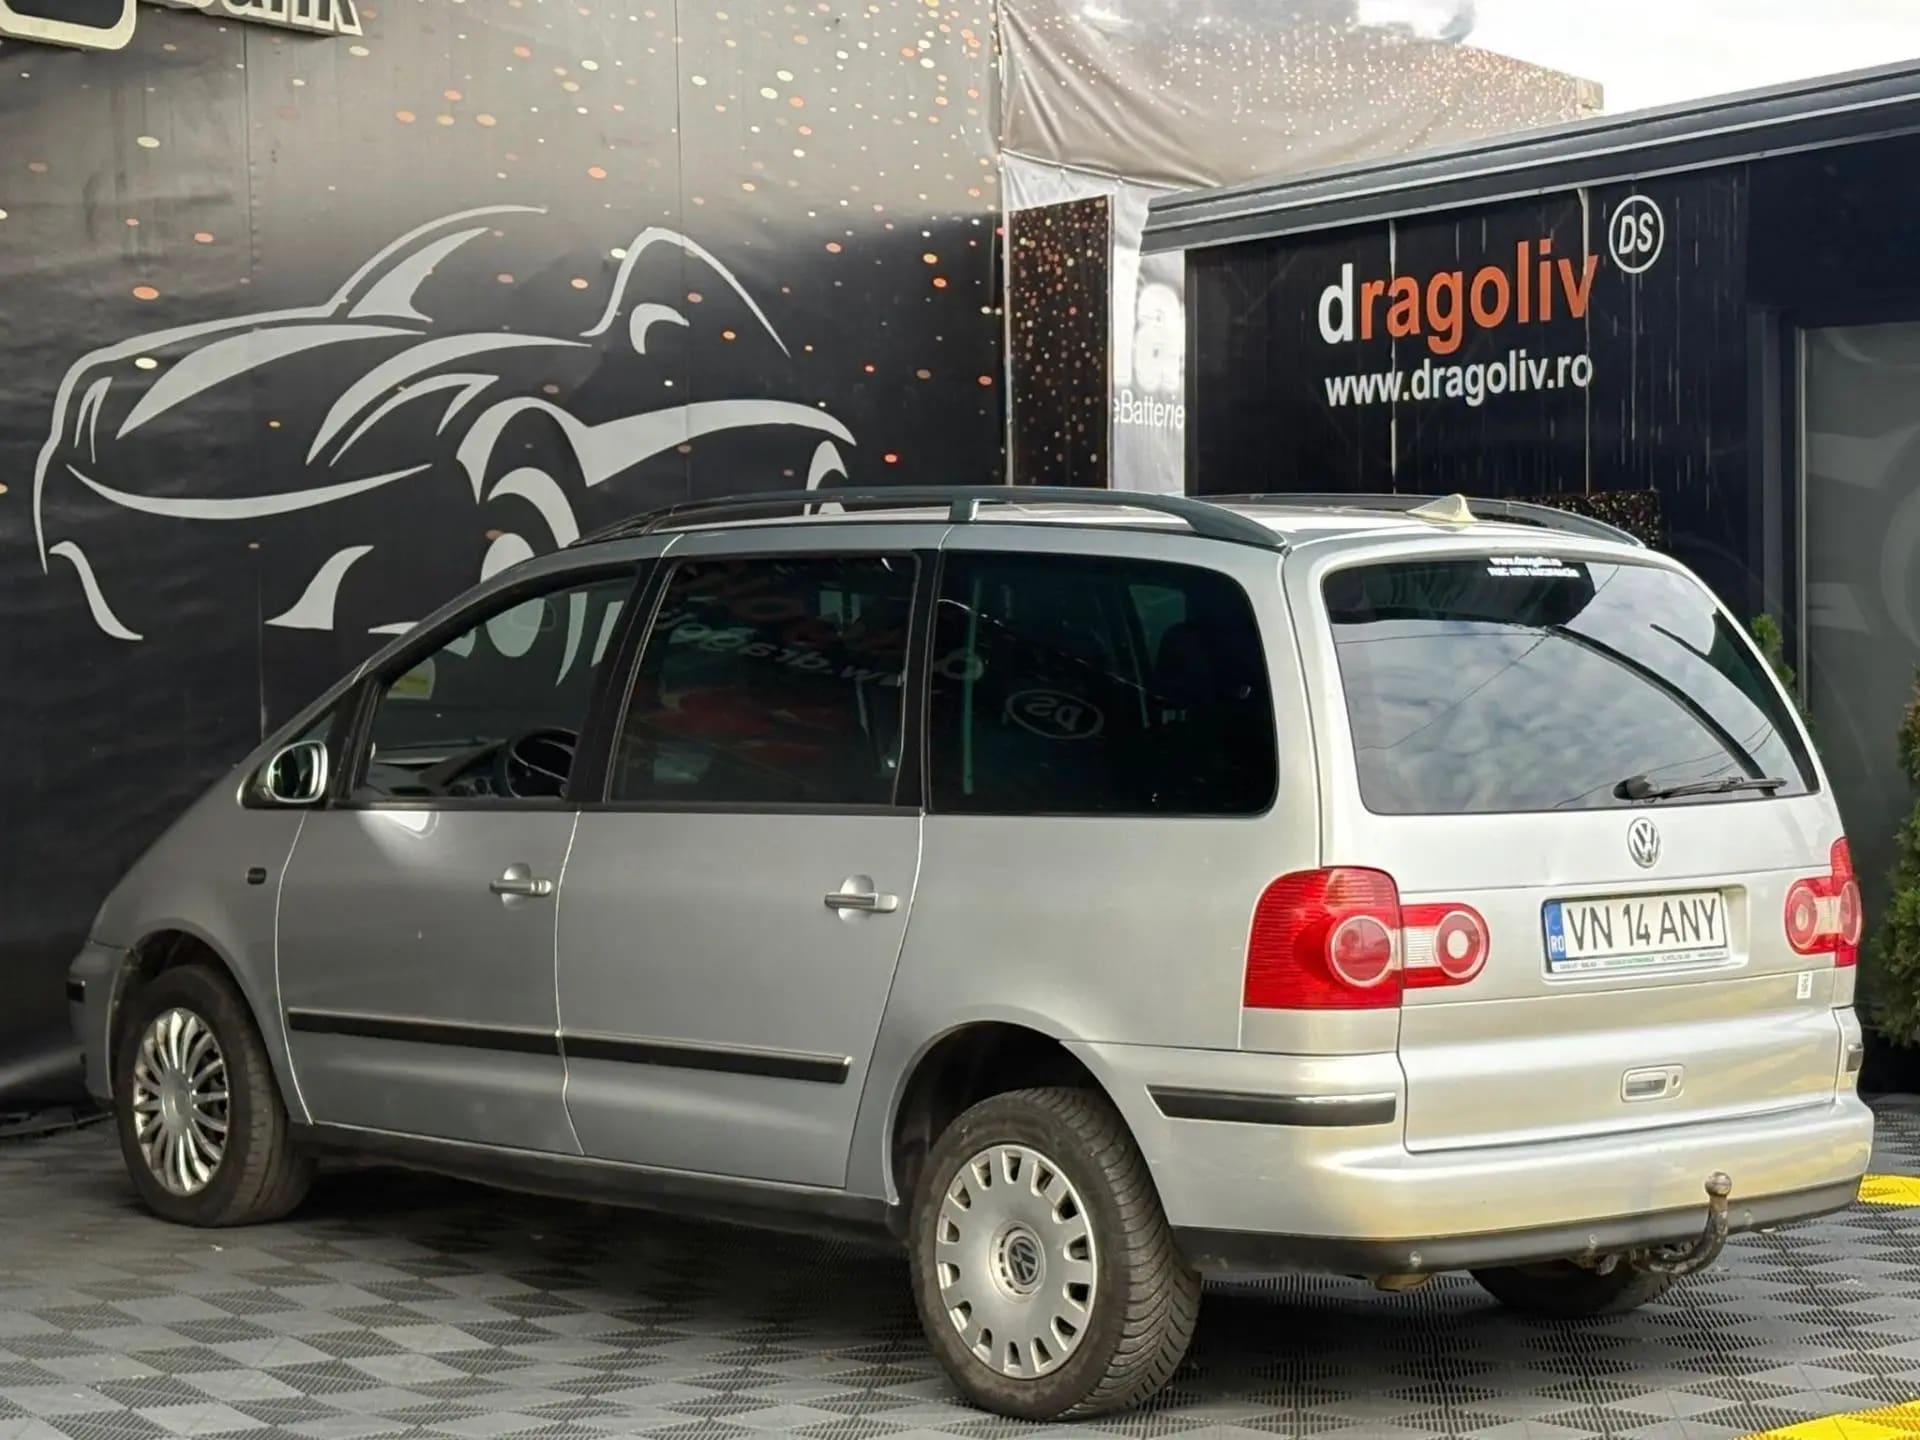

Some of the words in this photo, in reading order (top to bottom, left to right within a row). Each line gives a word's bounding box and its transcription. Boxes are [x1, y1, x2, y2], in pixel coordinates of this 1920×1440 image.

[1618, 211, 1655, 256] DS
[1318, 238, 1599, 354] dragoliv
[1325, 349, 1594, 407] www.dragoliv.ro
[1550, 935, 1565, 952] RO
[1567, 906, 1614, 951] VN
[1622, 903, 1652, 947] 14
[1659, 897, 1718, 944] ANY
